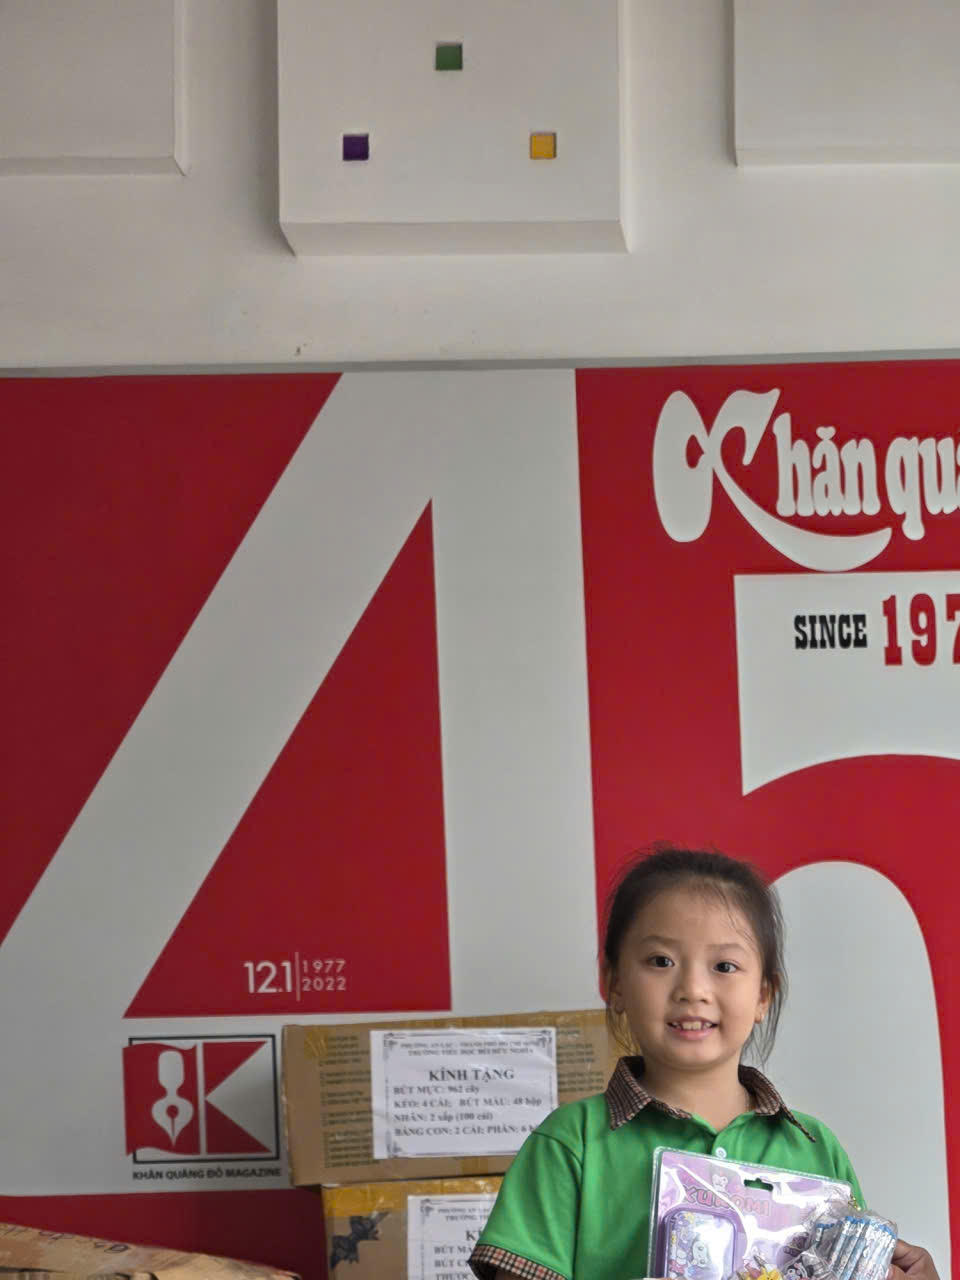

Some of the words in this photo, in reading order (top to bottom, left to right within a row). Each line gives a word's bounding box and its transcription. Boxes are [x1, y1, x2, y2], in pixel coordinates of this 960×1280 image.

[652, 387, 893, 572] Khăn
[793, 613, 869, 650] SINCE
[302, 958, 347, 975] 1977
[302, 976, 347, 992] 2022
[428, 1067, 467, 1082] KÍNH
[472, 1068, 515, 1083] TẶNG
[225, 1167, 281, 1178] MAGAZINE
